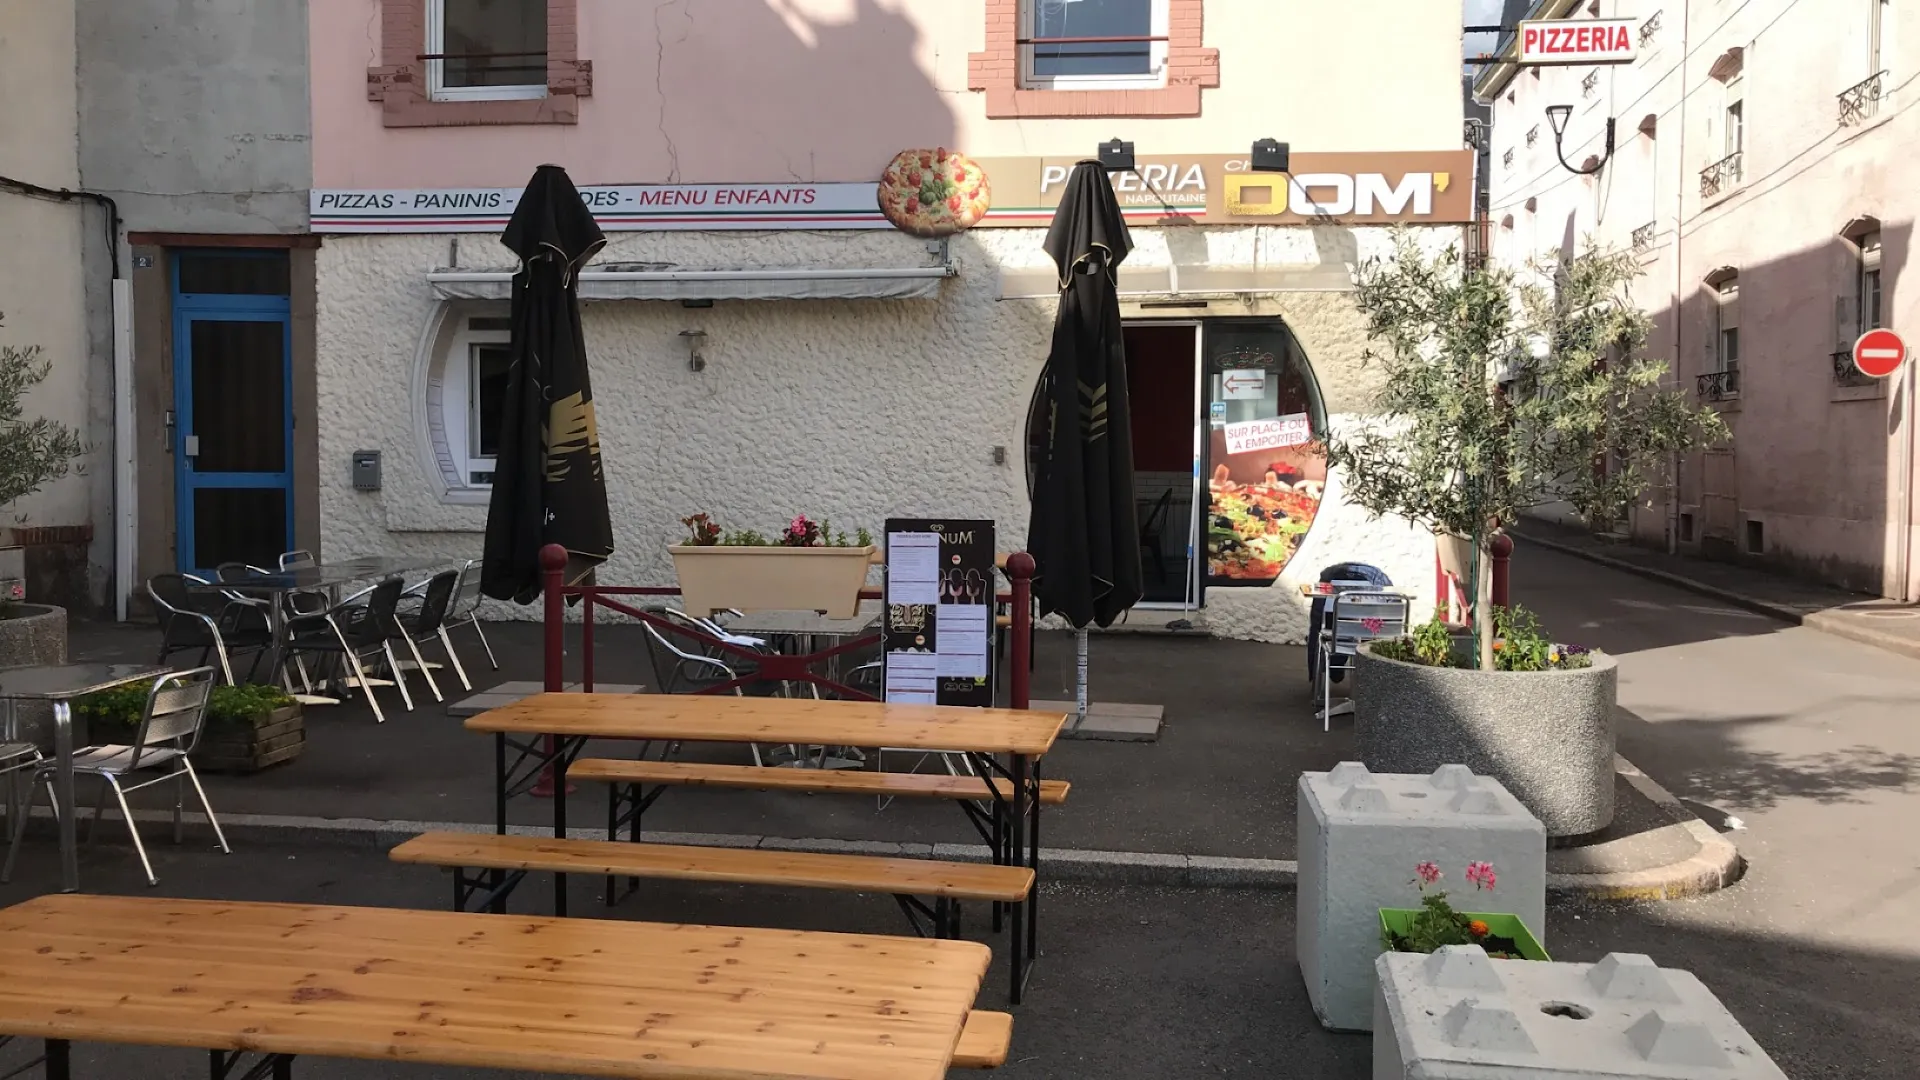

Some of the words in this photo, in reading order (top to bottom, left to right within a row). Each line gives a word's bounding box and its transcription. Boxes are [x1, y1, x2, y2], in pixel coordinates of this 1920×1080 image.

[1524, 26, 1630, 53] PIZZERIA
[1041, 163, 1206, 193] PERIA
[319, 194, 394, 209] PIZZAS
[413, 193, 501, 209] PANINIS
[639, 190, 707, 206] MENU
[714, 189, 816, 205] ENFANTS
[1125, 193, 1206, 204] NAPOLITAINE
[1228, 426, 1248, 439] SUR
[1251, 420, 1286, 435] PLACE
[1288, 418, 1305, 430] OU
[1245, 432, 1303, 448] EMPORTER
